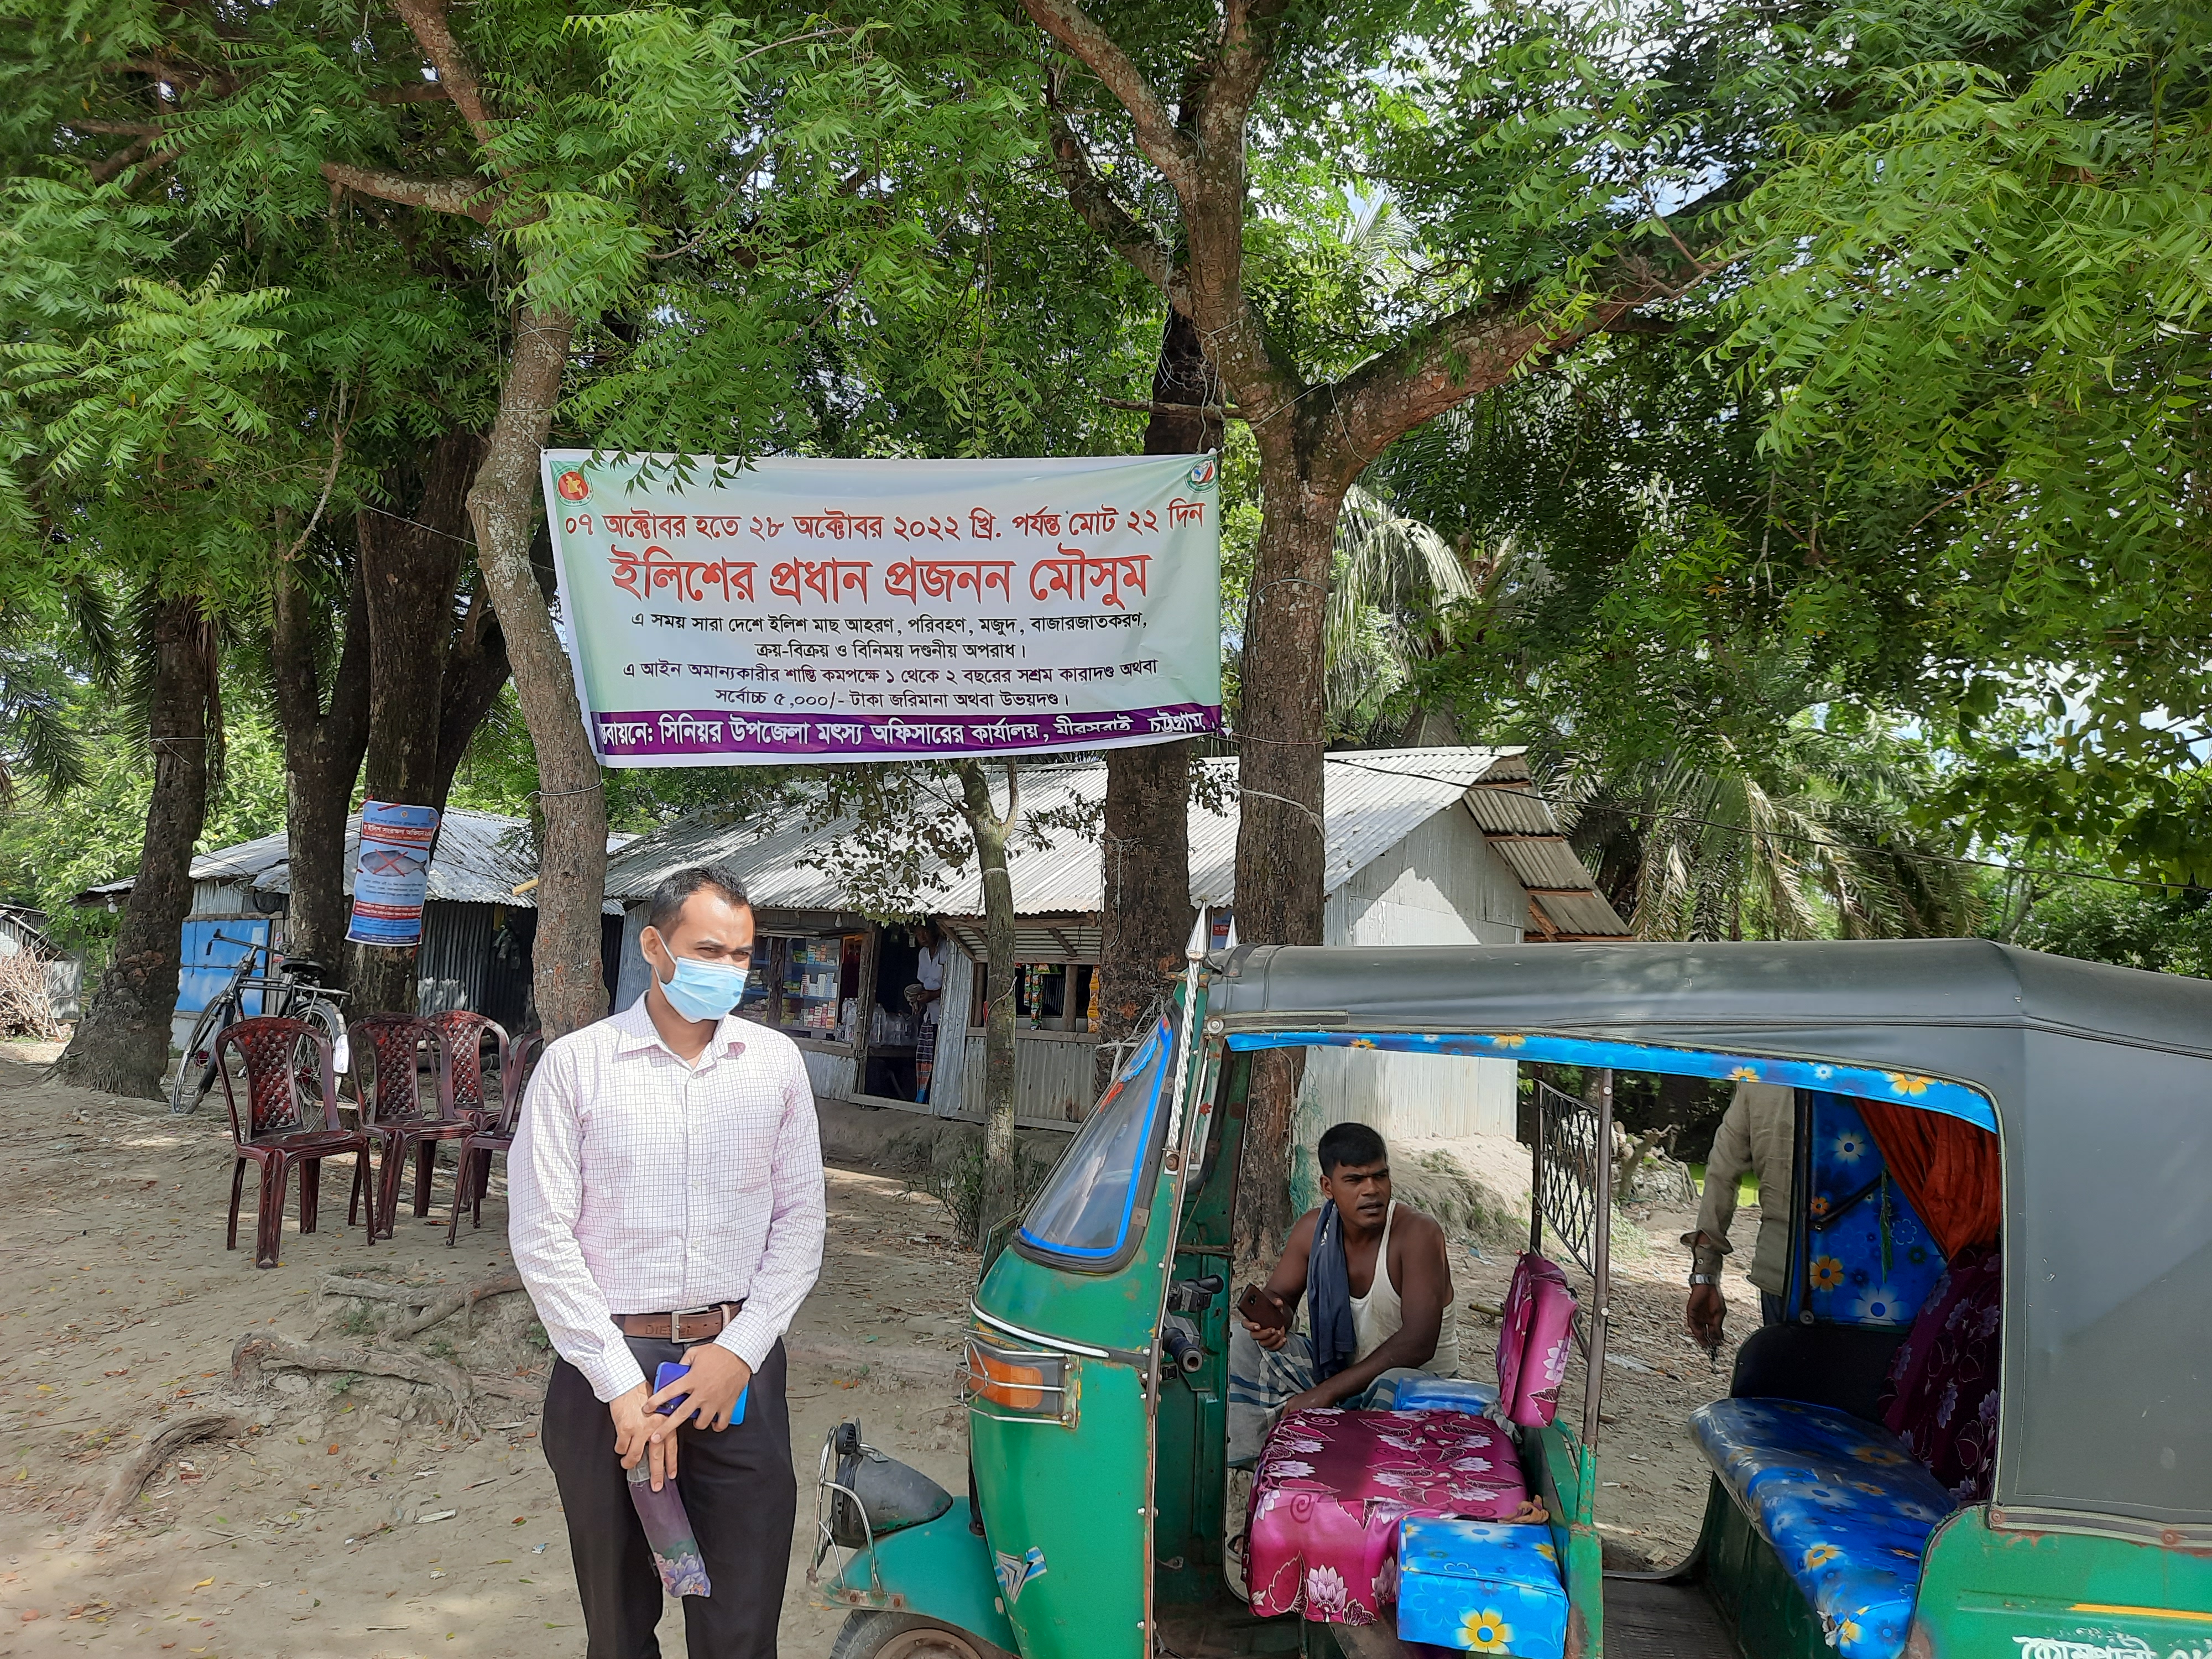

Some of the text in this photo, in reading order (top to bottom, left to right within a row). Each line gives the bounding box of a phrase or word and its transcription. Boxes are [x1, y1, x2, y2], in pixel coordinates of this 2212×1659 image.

[565, 514, 593, 535] ০৭
[601, 507, 688, 540] অক্টোবর
[692, 515, 742, 540] হতে
[749, 515, 785, 541] ২৮
[791, 508, 885, 540] অক্টোবর
[894, 515, 961, 541] ২০২২
[1011, 505, 1062, 537] পর্যন্ত
[1068, 504, 1119, 536] মোট
[1126, 509, 1159, 535] ২২
[1167, 497, 1206, 529] দিন
[607, 542, 1152, 610] ইলিশের প্রধান প্রজনন মৌসুম
[632, 613, 644, 627] এ
[650, 614, 687, 630] সময়
[691, 617, 724, 632] সারা
[728, 617, 764, 633] দেশে
[767, 613, 809, 633] ইলিশ
[811, 618, 841, 635] মাছ
[844, 617, 902, 637] আহরণ,
[1029, 611, 1147, 633] বাজারজাতকরণ,
[754, 639, 831, 659] ক্রয়-বিক্রয়
[834, 645, 847, 657] ও
[853, 639, 905, 659] বিনিময়
[623, 664, 634, 677] এ
[639, 658, 683, 677] আইন
[687, 663, 781, 682] অমান্যকারীর
[783, 664, 817, 683] শাস্তি
[820, 668, 881, 684] কমপক্ষে
[885, 670, 895, 684] ১
[901, 668, 940, 684] থেকে
[946, 670, 958, 685] ২
[961, 669, 1013, 685] বছরের
[1016, 668, 1054, 684] সশ্রম
[1119, 659, 1159, 677] অথবা
[714, 686, 769, 704] সর্বোচ্চ
[848, 689, 884, 708] টাকা
[888, 689, 950, 708] জরিমানা
[952, 692, 996, 708] অথবা
[658, 713, 724, 744] সিনিয়র
[727, 712, 812, 745] উপজেলা
[815, 723, 865, 745] মৎস্য
[869, 717, 965, 745] অফিসারের
[968, 717, 1049, 744] কার্যালয়,
